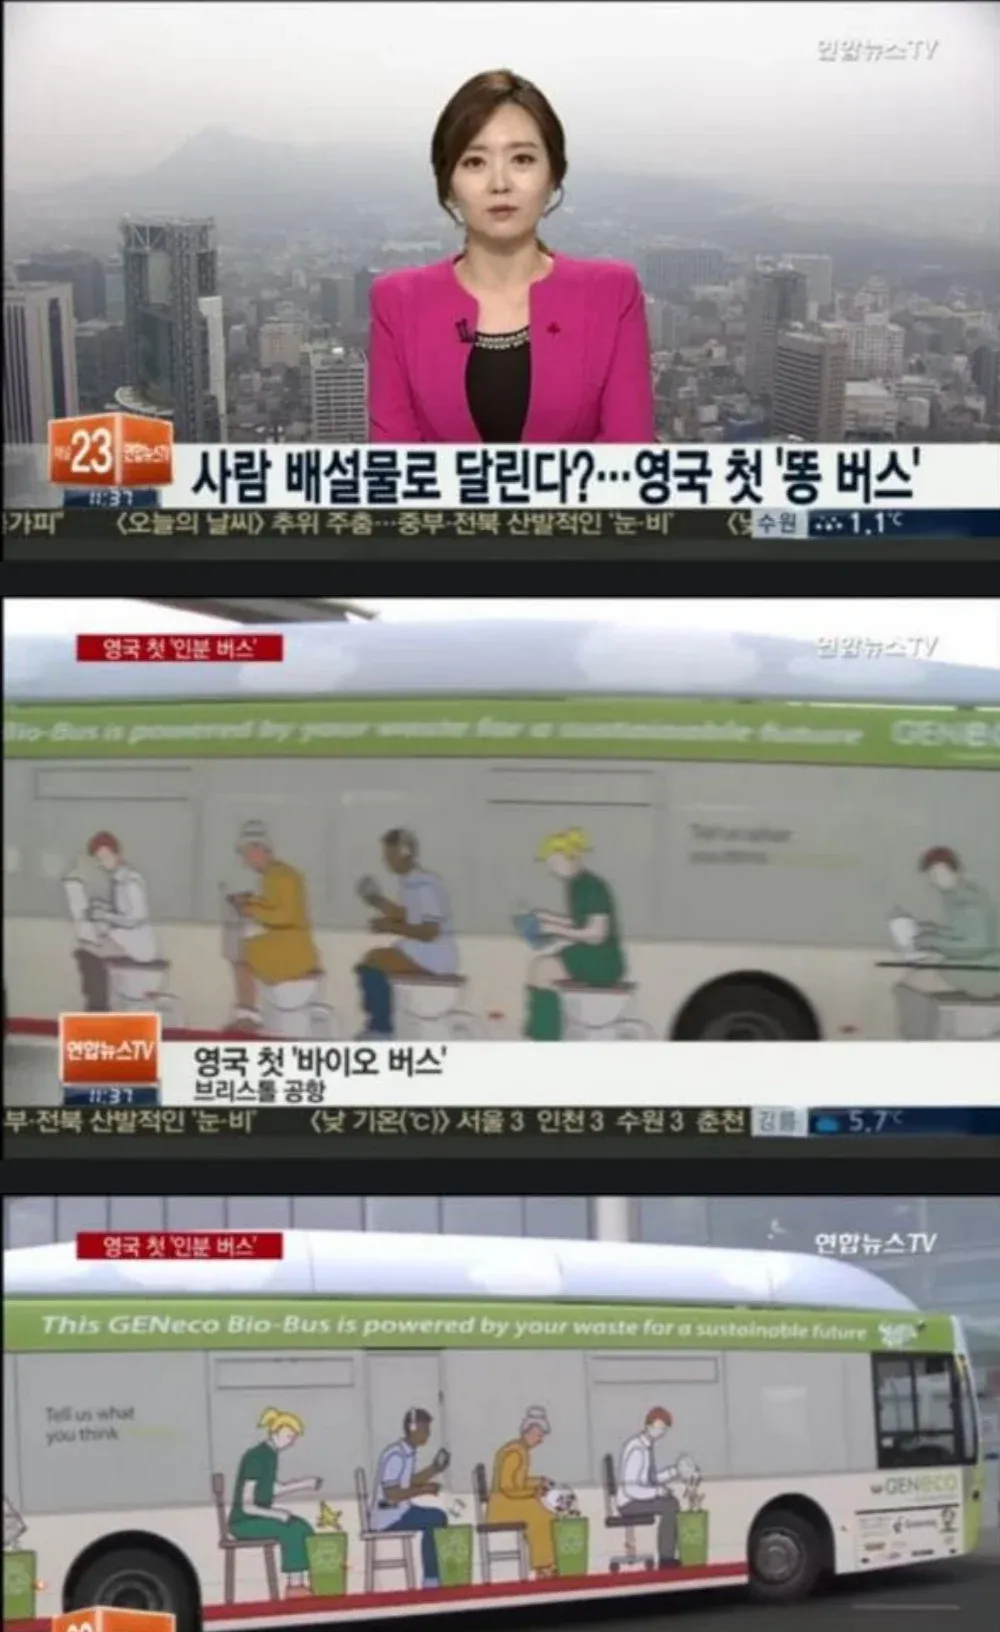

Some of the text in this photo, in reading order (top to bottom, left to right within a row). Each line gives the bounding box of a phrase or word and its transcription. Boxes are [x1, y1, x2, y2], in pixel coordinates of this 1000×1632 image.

[41, 1315, 868, 1341] This GENeco Bio-Bus is powered by your waste for a sustainable future
[46, 1406, 135, 1423] Tell us what
[46, 1428, 119, 1447] you think
